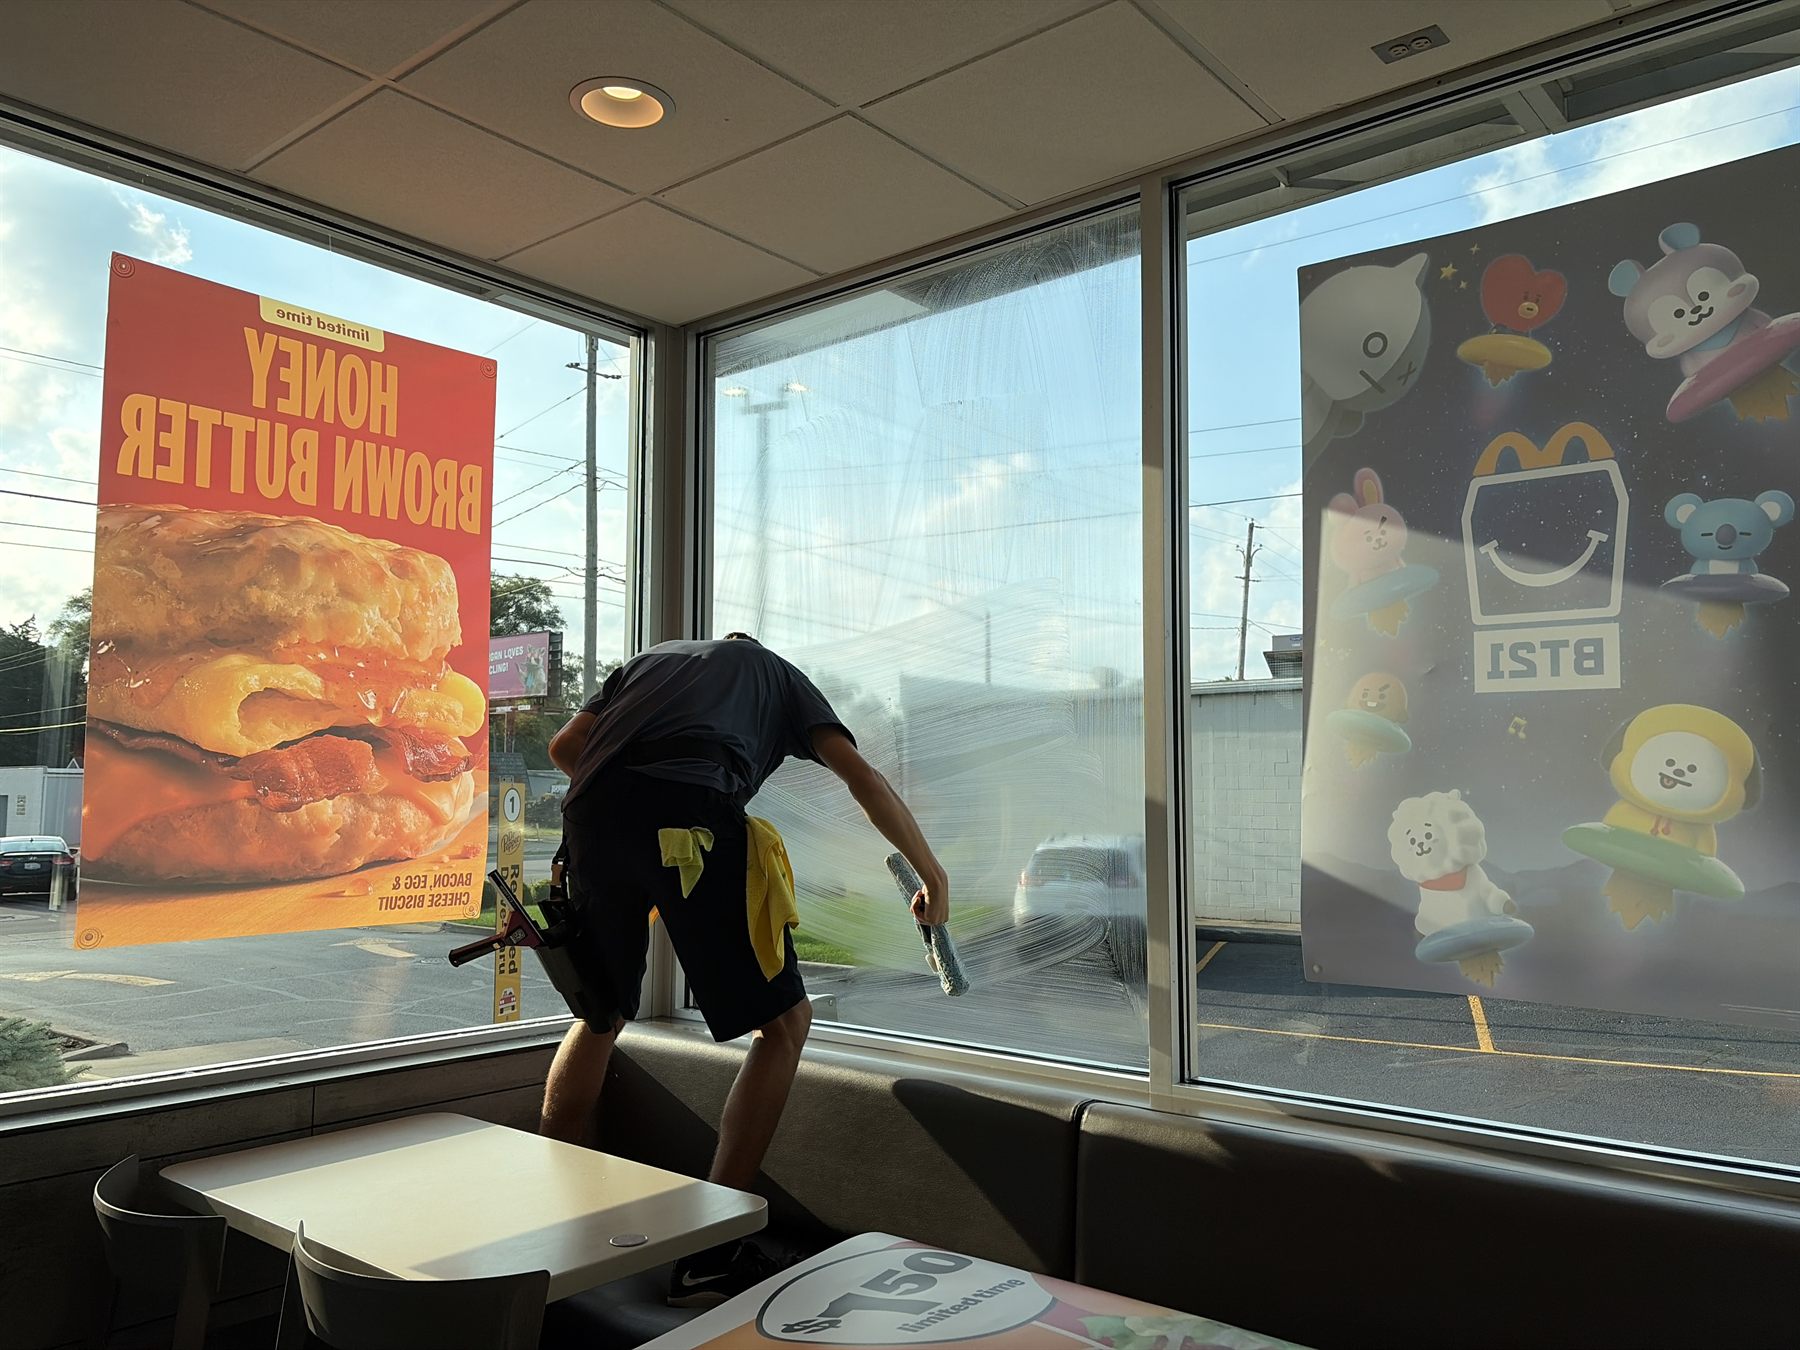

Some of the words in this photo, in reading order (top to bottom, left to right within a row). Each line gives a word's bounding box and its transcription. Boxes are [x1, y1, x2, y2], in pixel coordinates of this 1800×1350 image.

[504, 646, 523, 658] LOVES
[509, 796, 515, 813] 1
[896, 1293, 982, 1332] limited
[975, 1279, 1026, 1299] time
